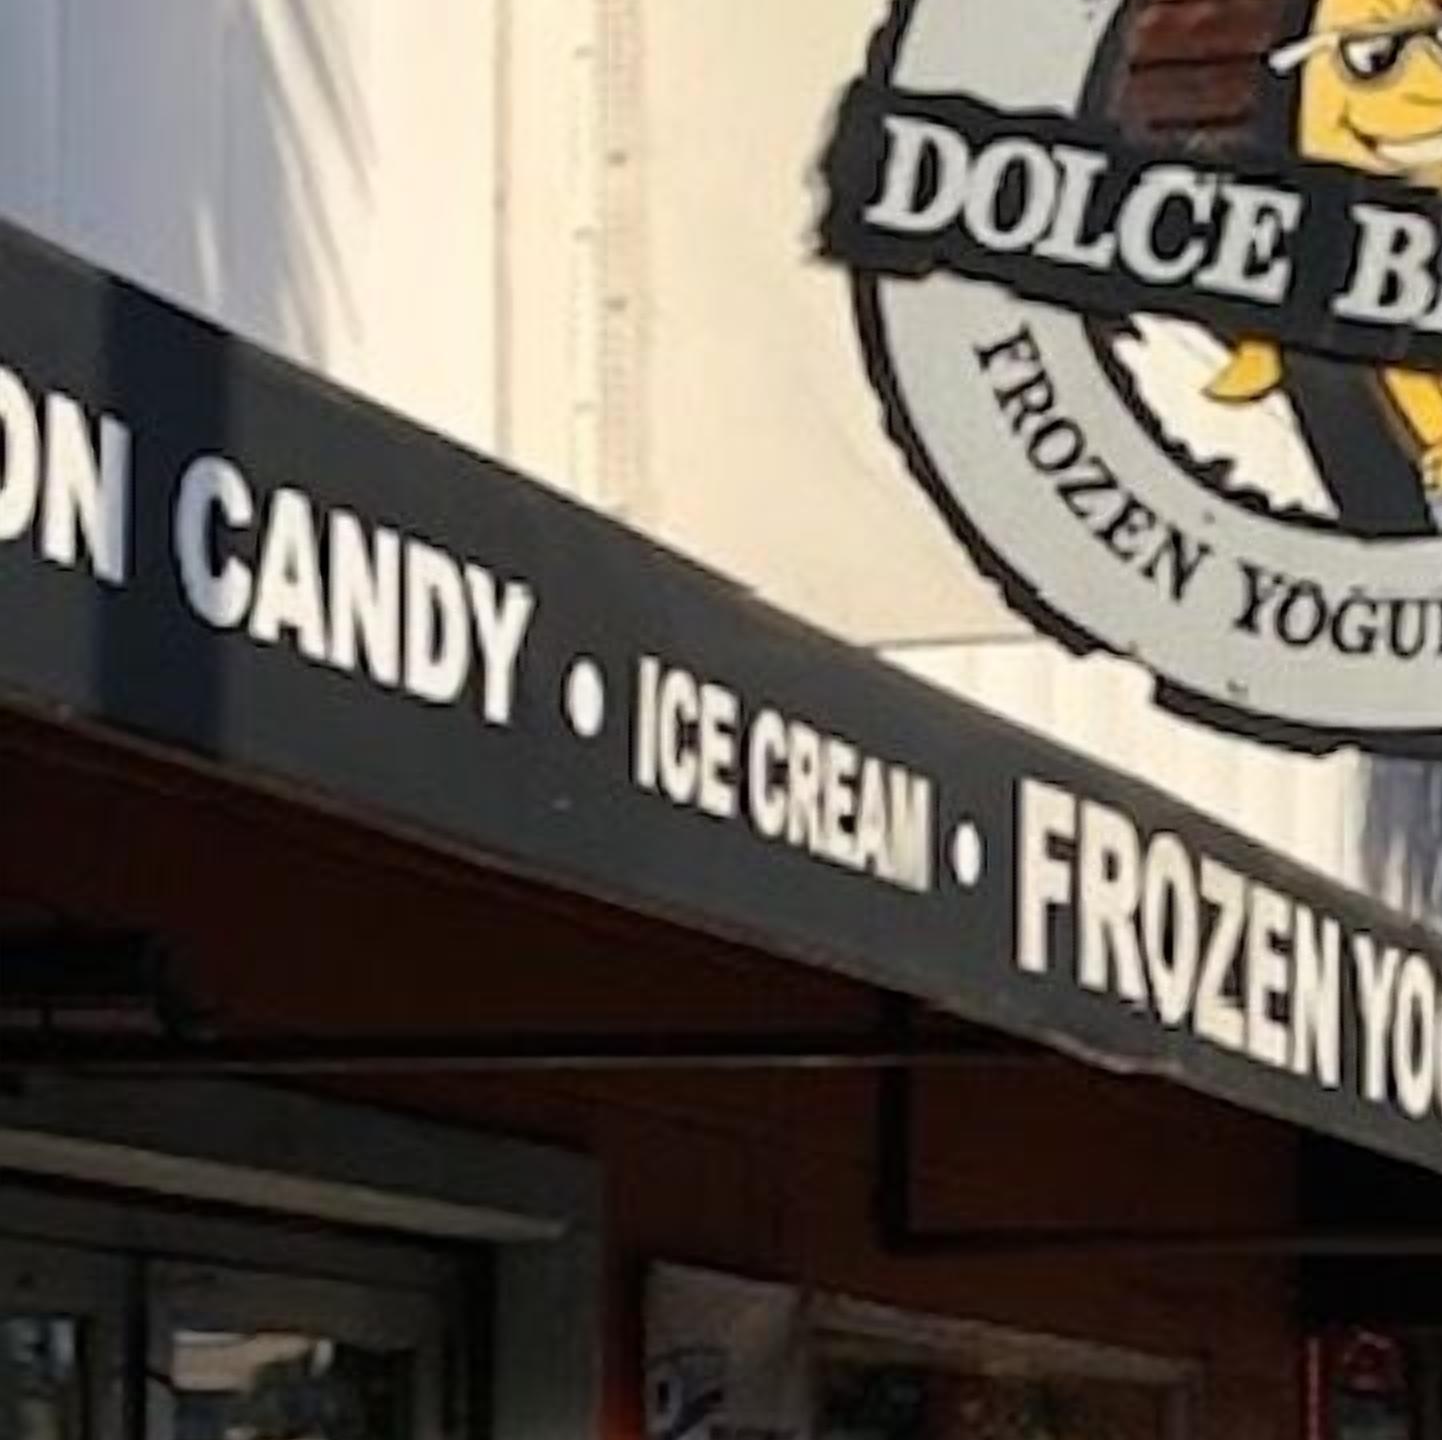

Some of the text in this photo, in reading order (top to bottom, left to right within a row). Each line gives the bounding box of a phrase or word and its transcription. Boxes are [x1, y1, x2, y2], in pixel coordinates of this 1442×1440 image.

[865, 113, 1304, 304] DOLCE
[975, 322, 1210, 602] FROZEN
[174, 454, 536, 725] CANDY
[633, 655, 741, 818] ICE
[748, 707, 935, 893] CREAM
[1015, 775, 1342, 1089] FROZEN
